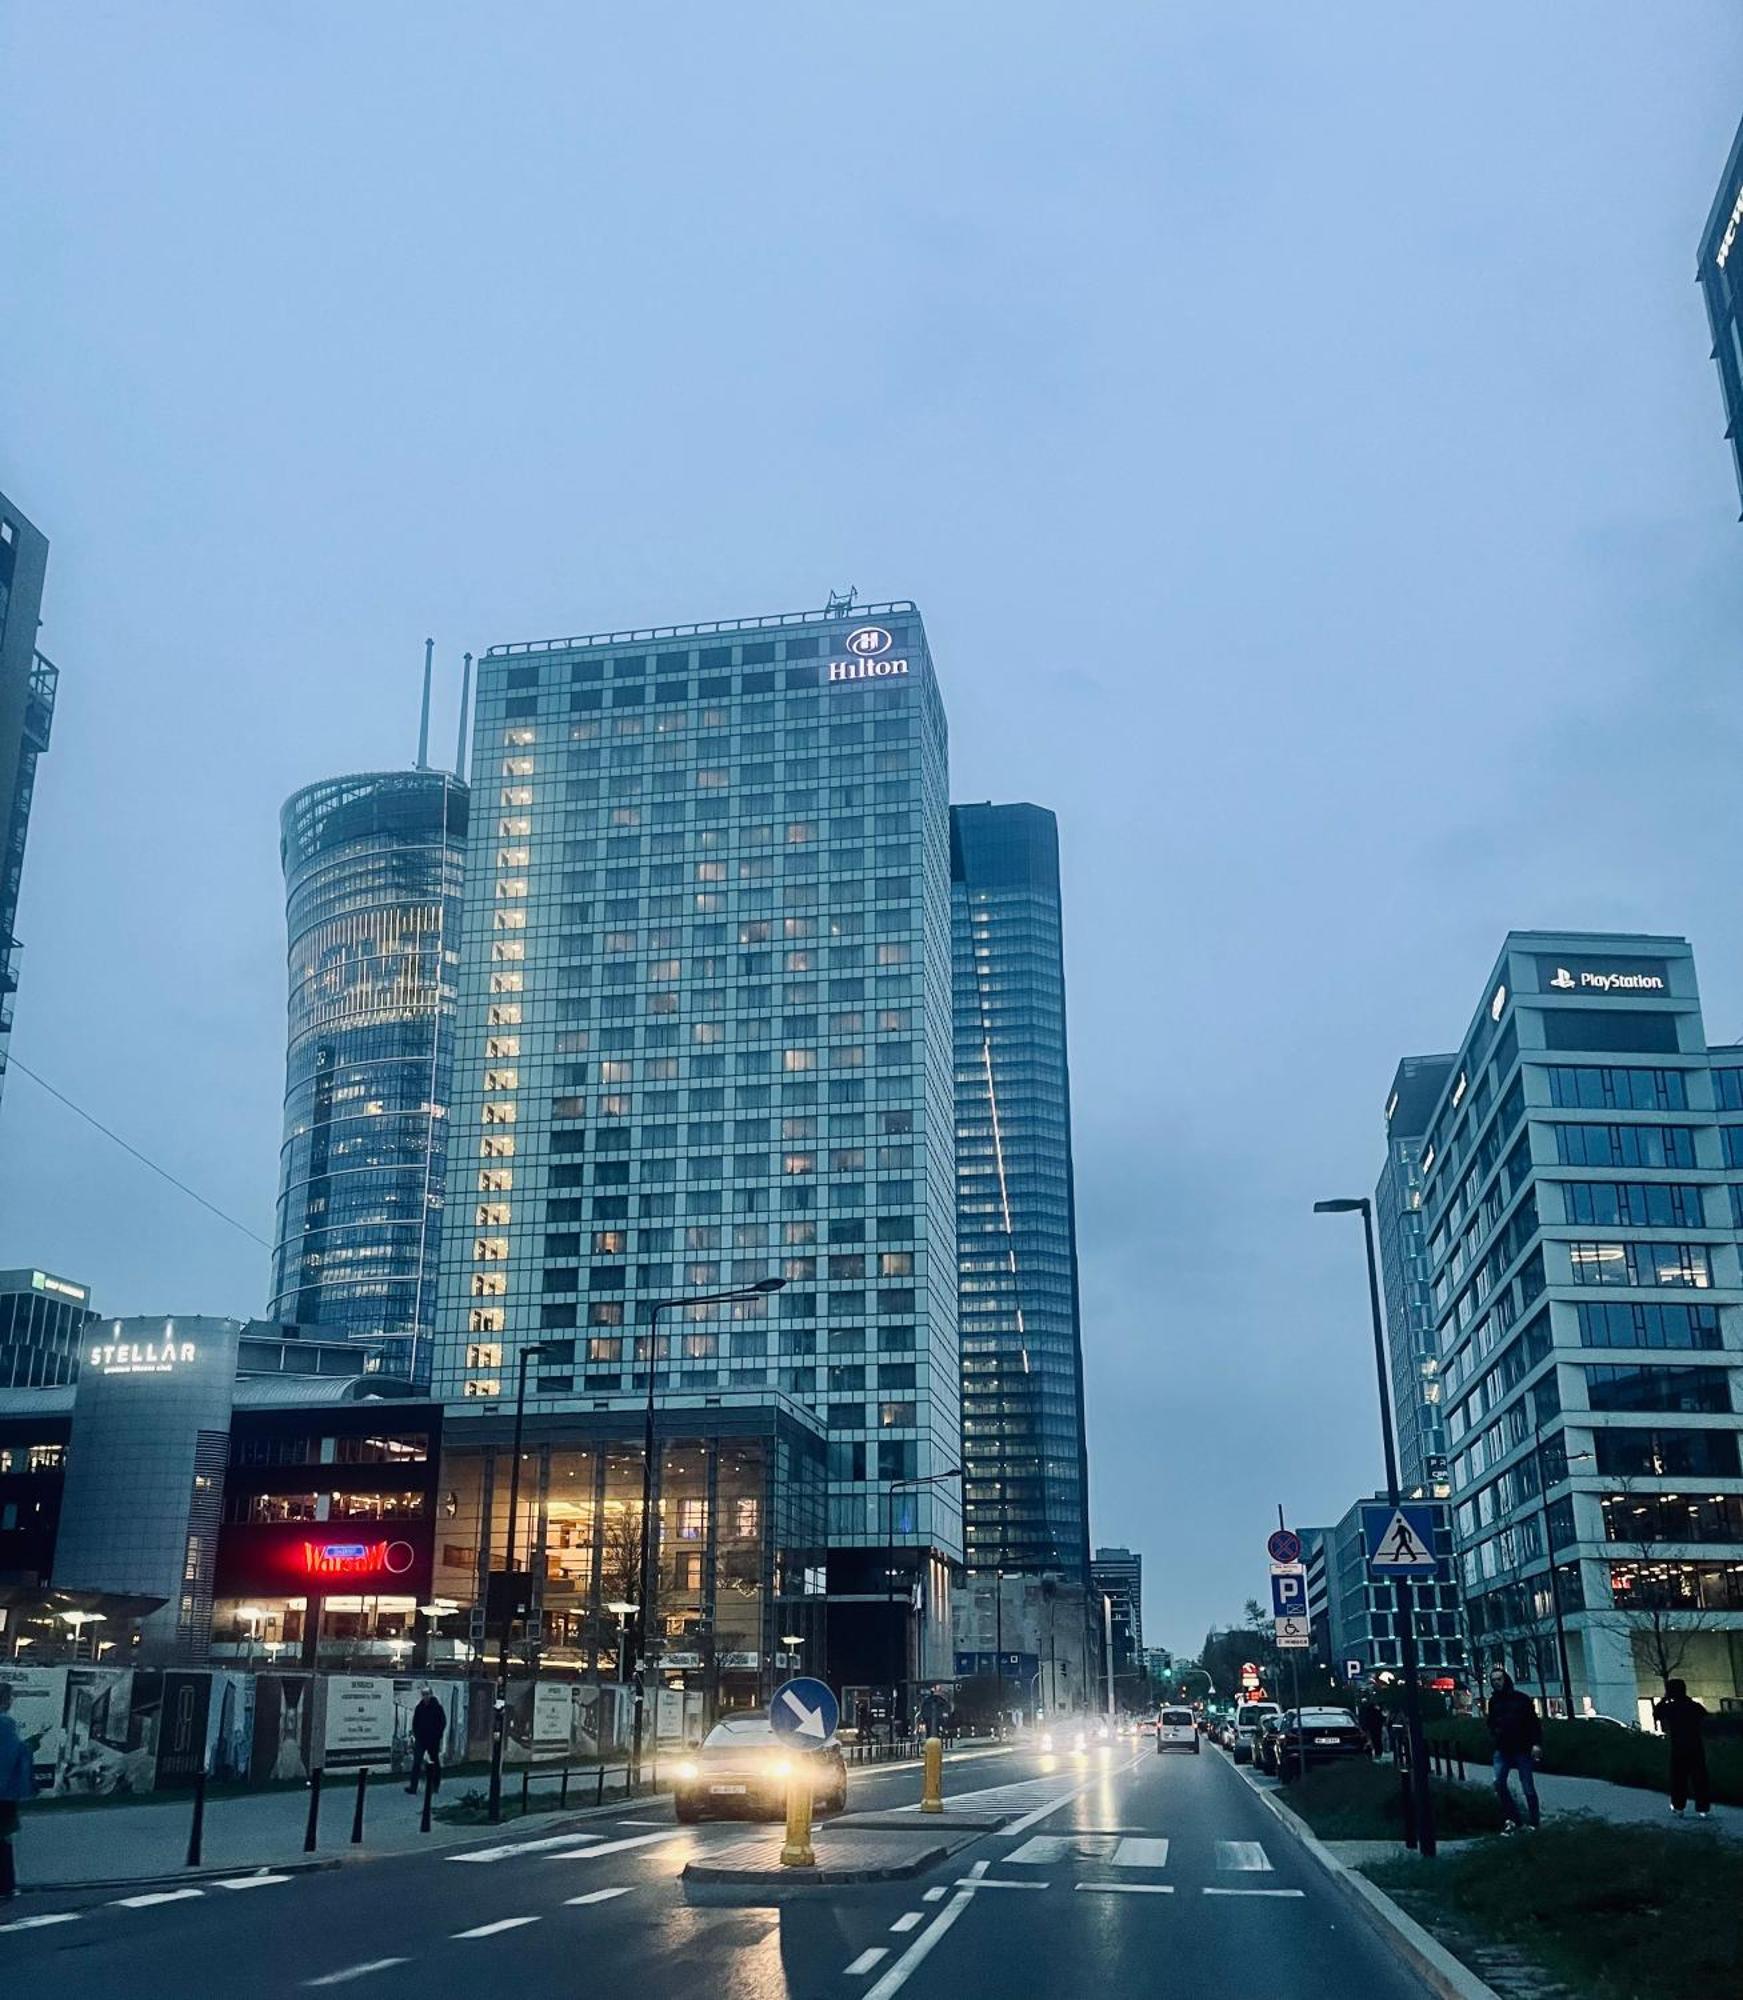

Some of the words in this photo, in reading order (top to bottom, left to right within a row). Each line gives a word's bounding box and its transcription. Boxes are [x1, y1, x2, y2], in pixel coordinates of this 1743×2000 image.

[829, 658, 909, 681] Hilton
[1581, 972, 1664, 992] PlayStation
[90, 1343, 196, 1366] STELLAR
[1280, 1578, 1299, 1604] P
[1347, 1660, 1360, 1679] P
